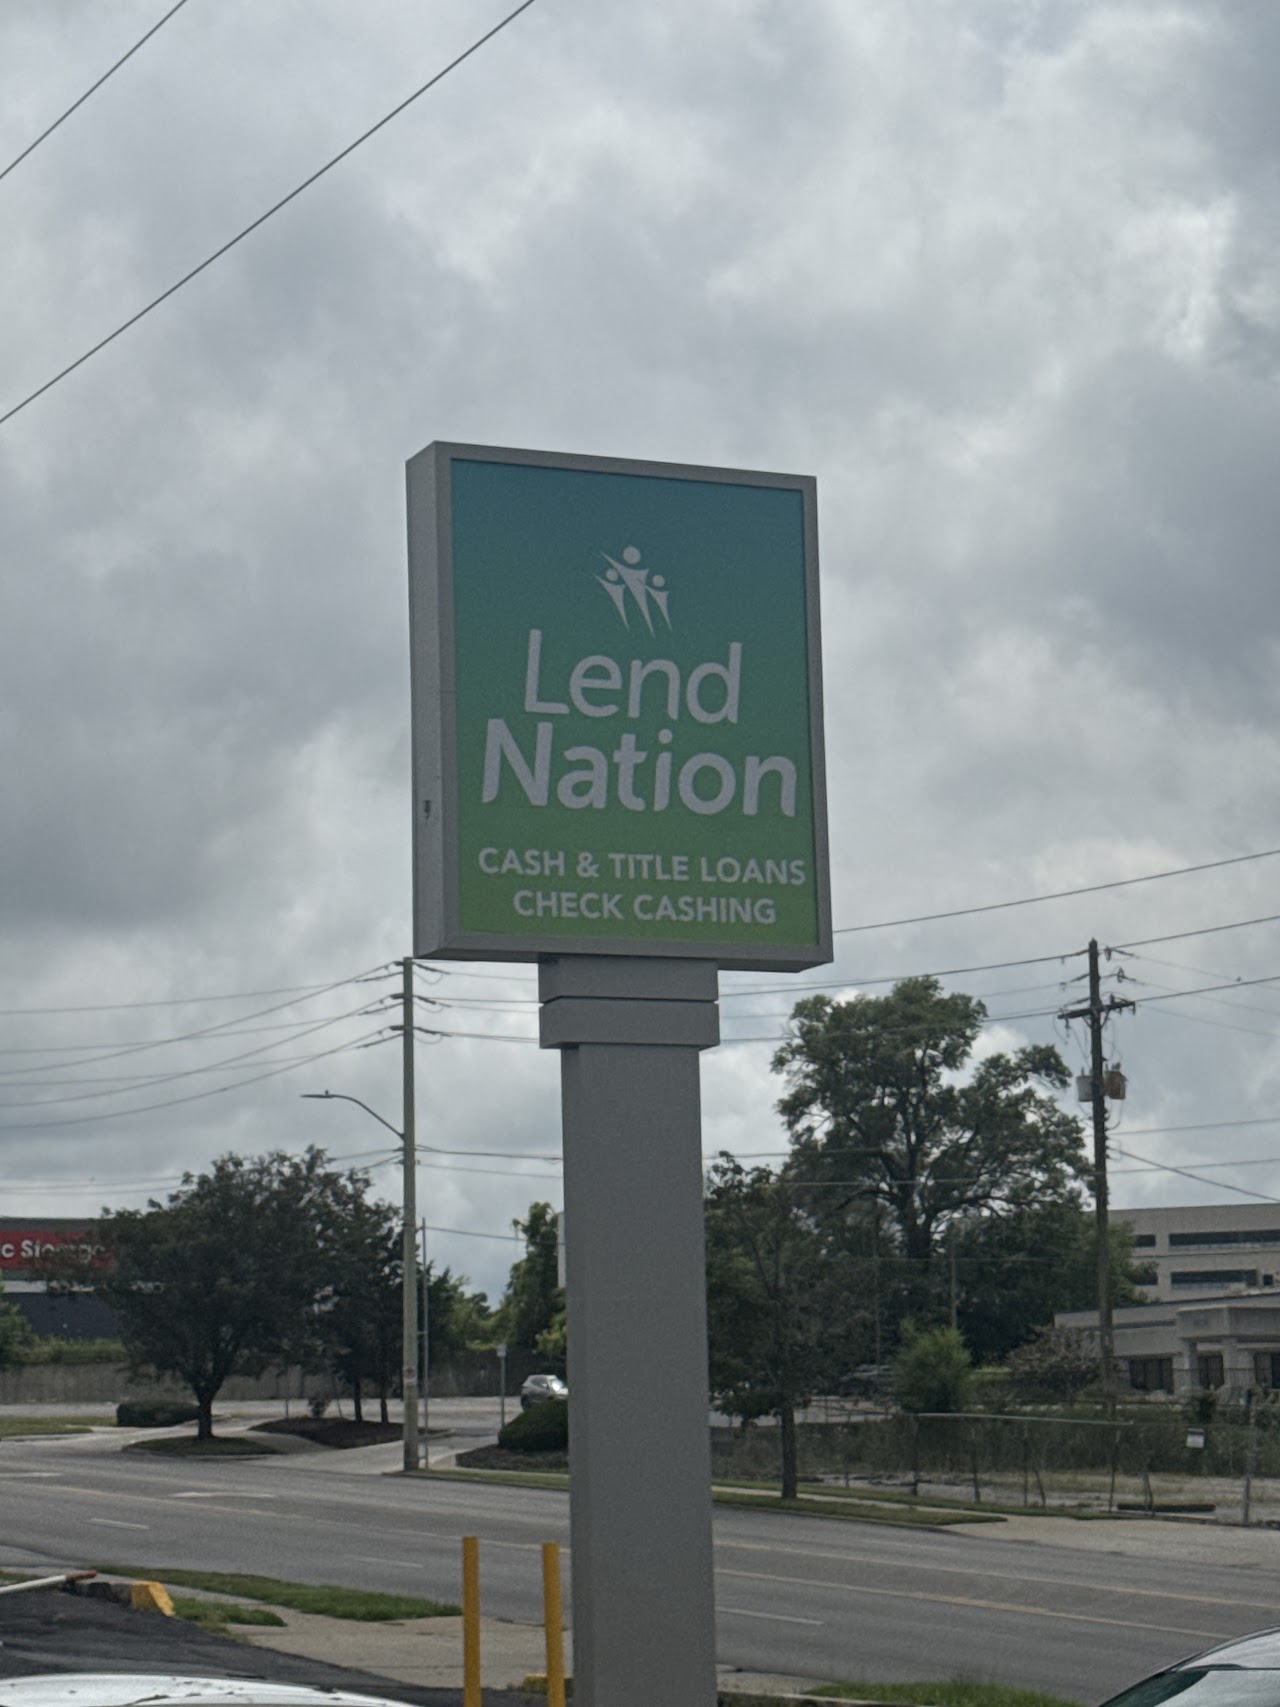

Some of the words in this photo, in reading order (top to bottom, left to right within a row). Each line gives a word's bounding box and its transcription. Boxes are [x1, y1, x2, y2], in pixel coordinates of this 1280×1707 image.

[524, 629, 742, 724] Lend
[482, 718, 797, 817] Nation
[478, 847, 565, 876] CASH
[577, 851, 598, 877] &
[608, 853, 688, 880] TITLE
[702, 857, 807, 885] LOANS
[513, 890, 623, 919] CHECK
[634, 894, 776, 925] CASHING
